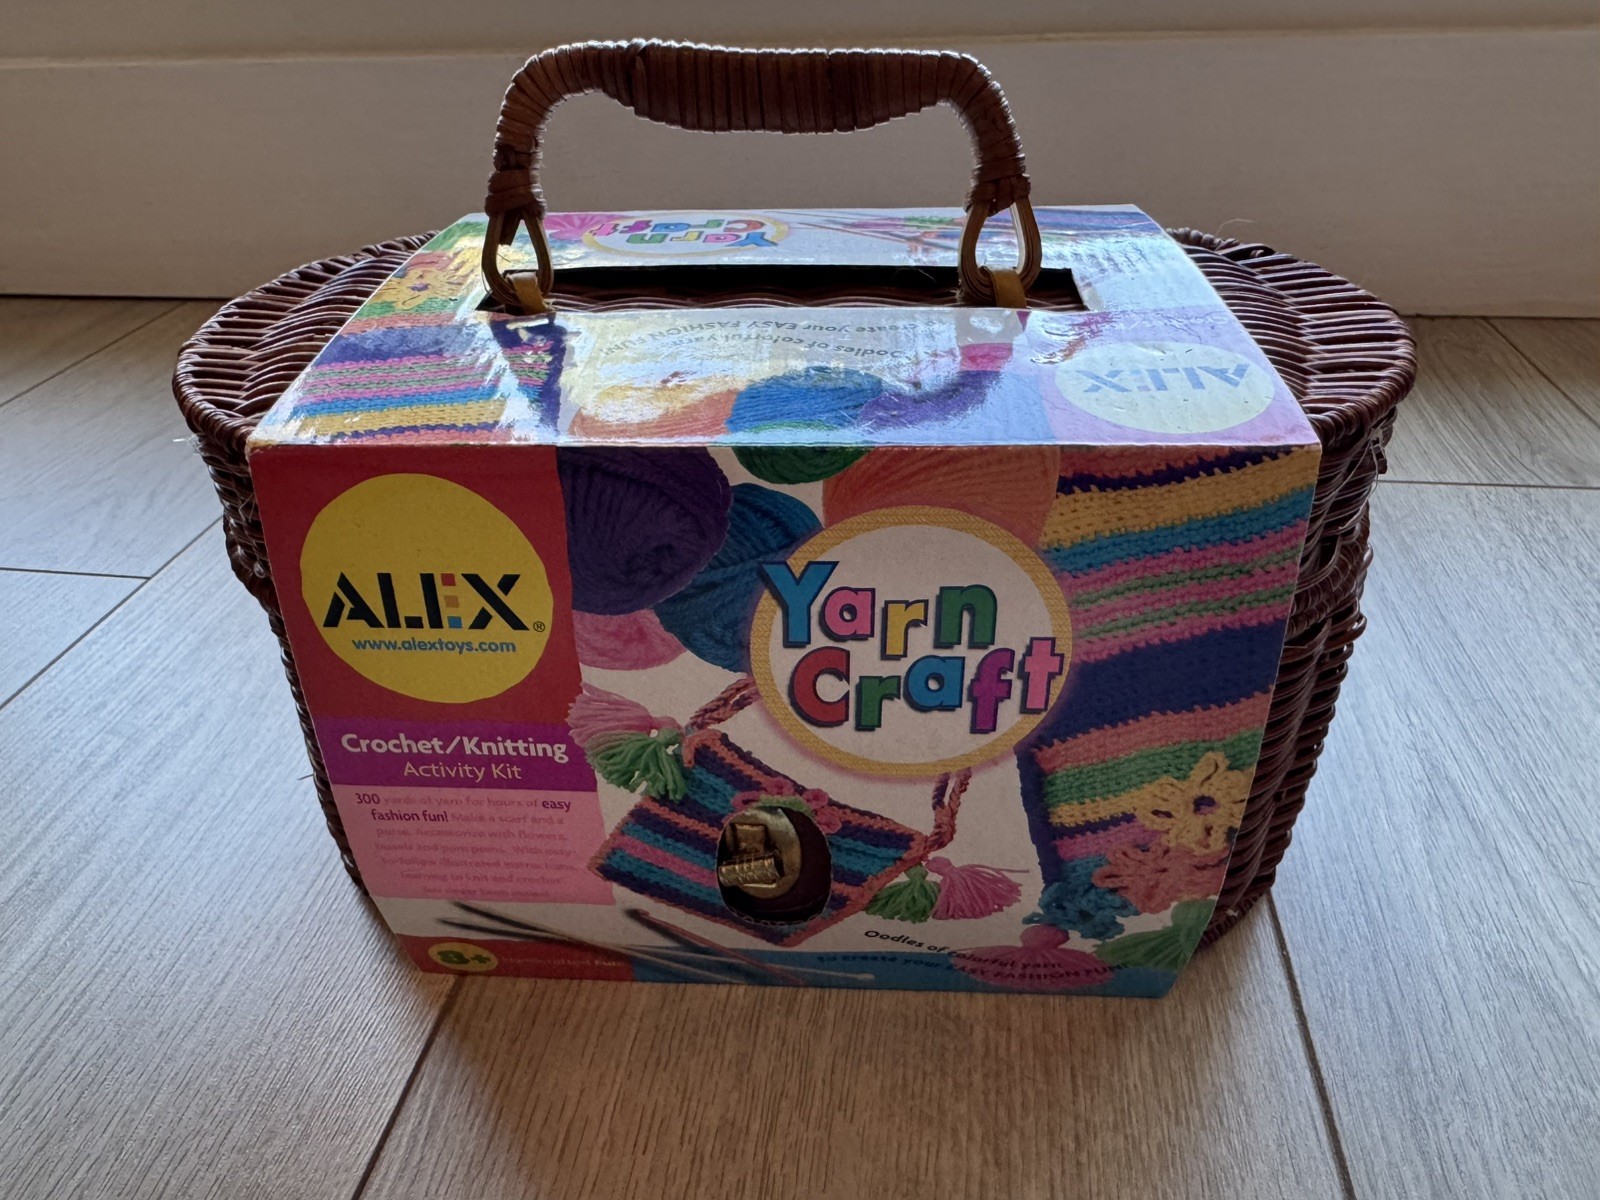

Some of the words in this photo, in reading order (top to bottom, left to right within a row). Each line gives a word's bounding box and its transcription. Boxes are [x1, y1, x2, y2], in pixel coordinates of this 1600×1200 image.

[592, 219, 765, 237] Craft
[626, 230, 779, 248] Yarn
[647, 320, 742, 341] FASHION
[747, 320, 799, 331] EASY
[801, 322, 850, 333] your
[806, 339, 831, 350] of
[834, 345, 905, 359] Oodles
[1075, 362, 1252, 392] ALEX
[322, 571, 531, 631] ALEX
[759, 560, 998, 661] Yarn
[351, 636, 517, 655] www.alextoys.com
[787, 636, 1065, 734] Craft
[340, 733, 570, 764] Crochet/Knitting
[403, 761, 486, 783] Activity
[491, 762, 522, 780] Kit
[355, 792, 381, 805] 300
[541, 799, 572, 813] easy
[371, 808, 420, 821] fashion
[422, 809, 449, 823] fun!
[864, 930, 925, 948] Oodles
[926, 944, 950, 953] of
[947, 951, 1016, 968] colorful
[902, 959, 942, 968] your
